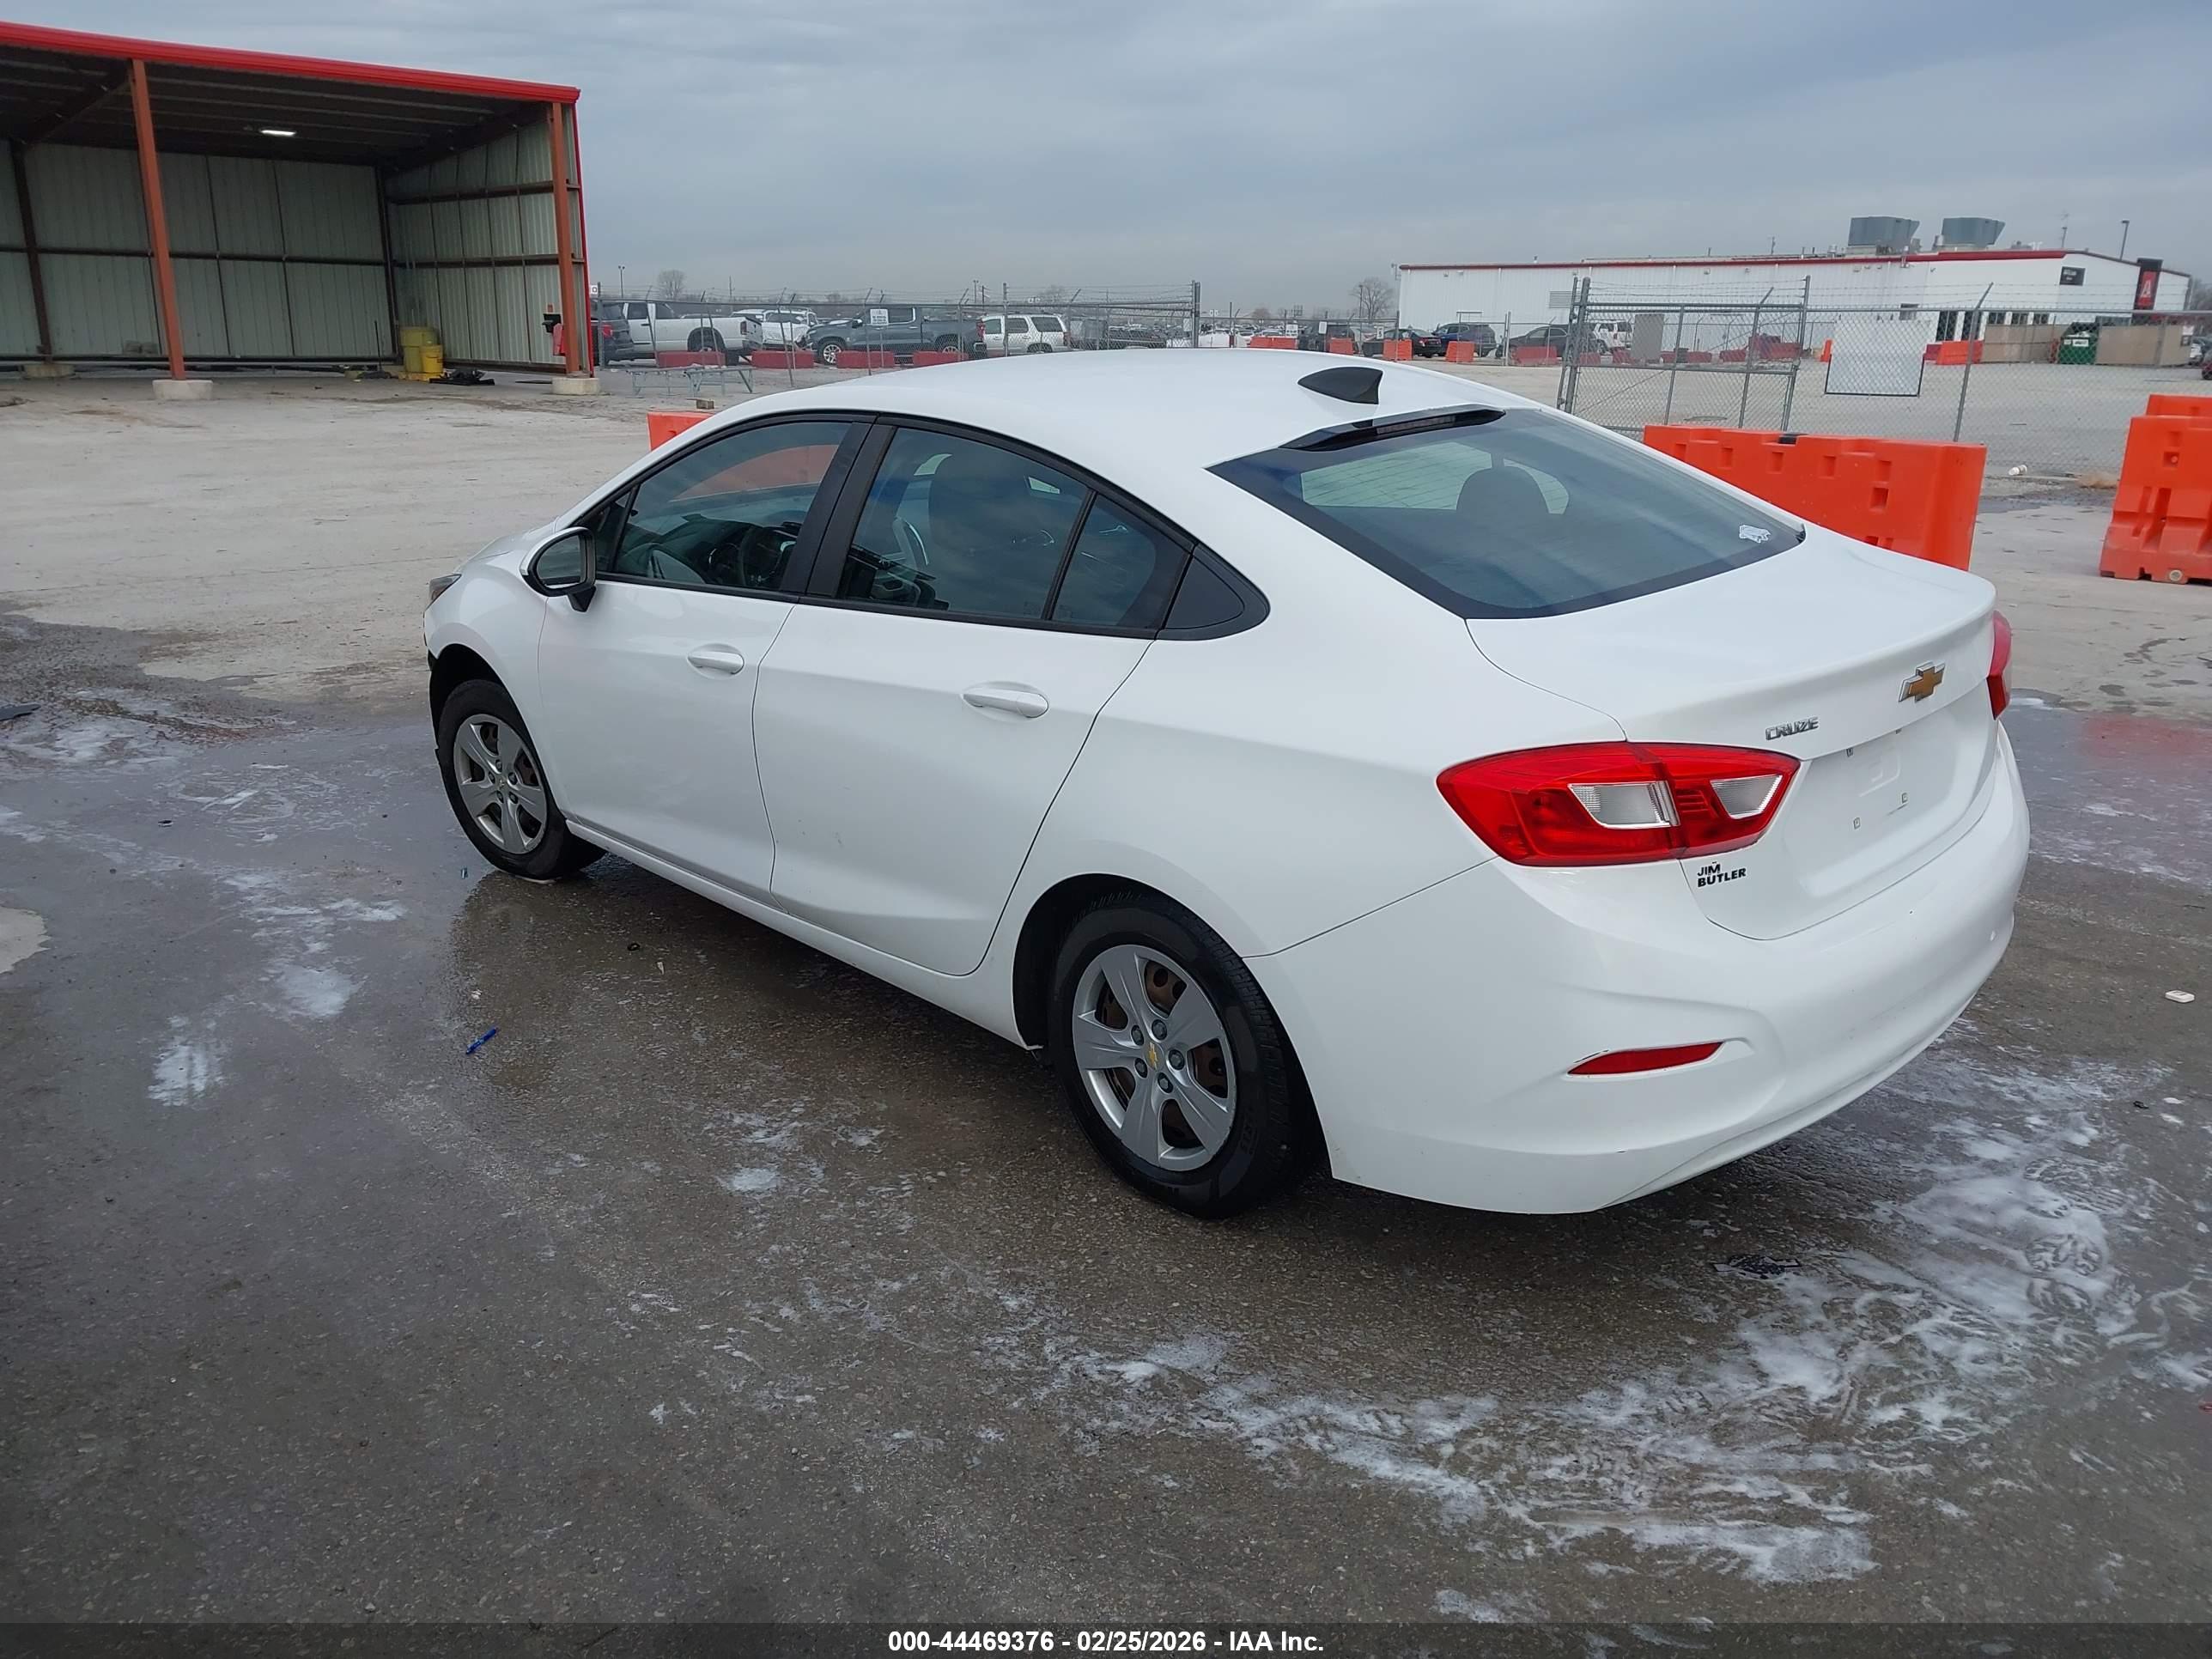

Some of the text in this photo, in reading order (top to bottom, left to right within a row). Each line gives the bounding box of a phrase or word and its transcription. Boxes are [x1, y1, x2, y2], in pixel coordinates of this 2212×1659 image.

[1765, 716, 1819, 740] CRUZE
[1697, 864, 1721, 876] JIM
[1697, 867, 1747, 888] BUTLER
